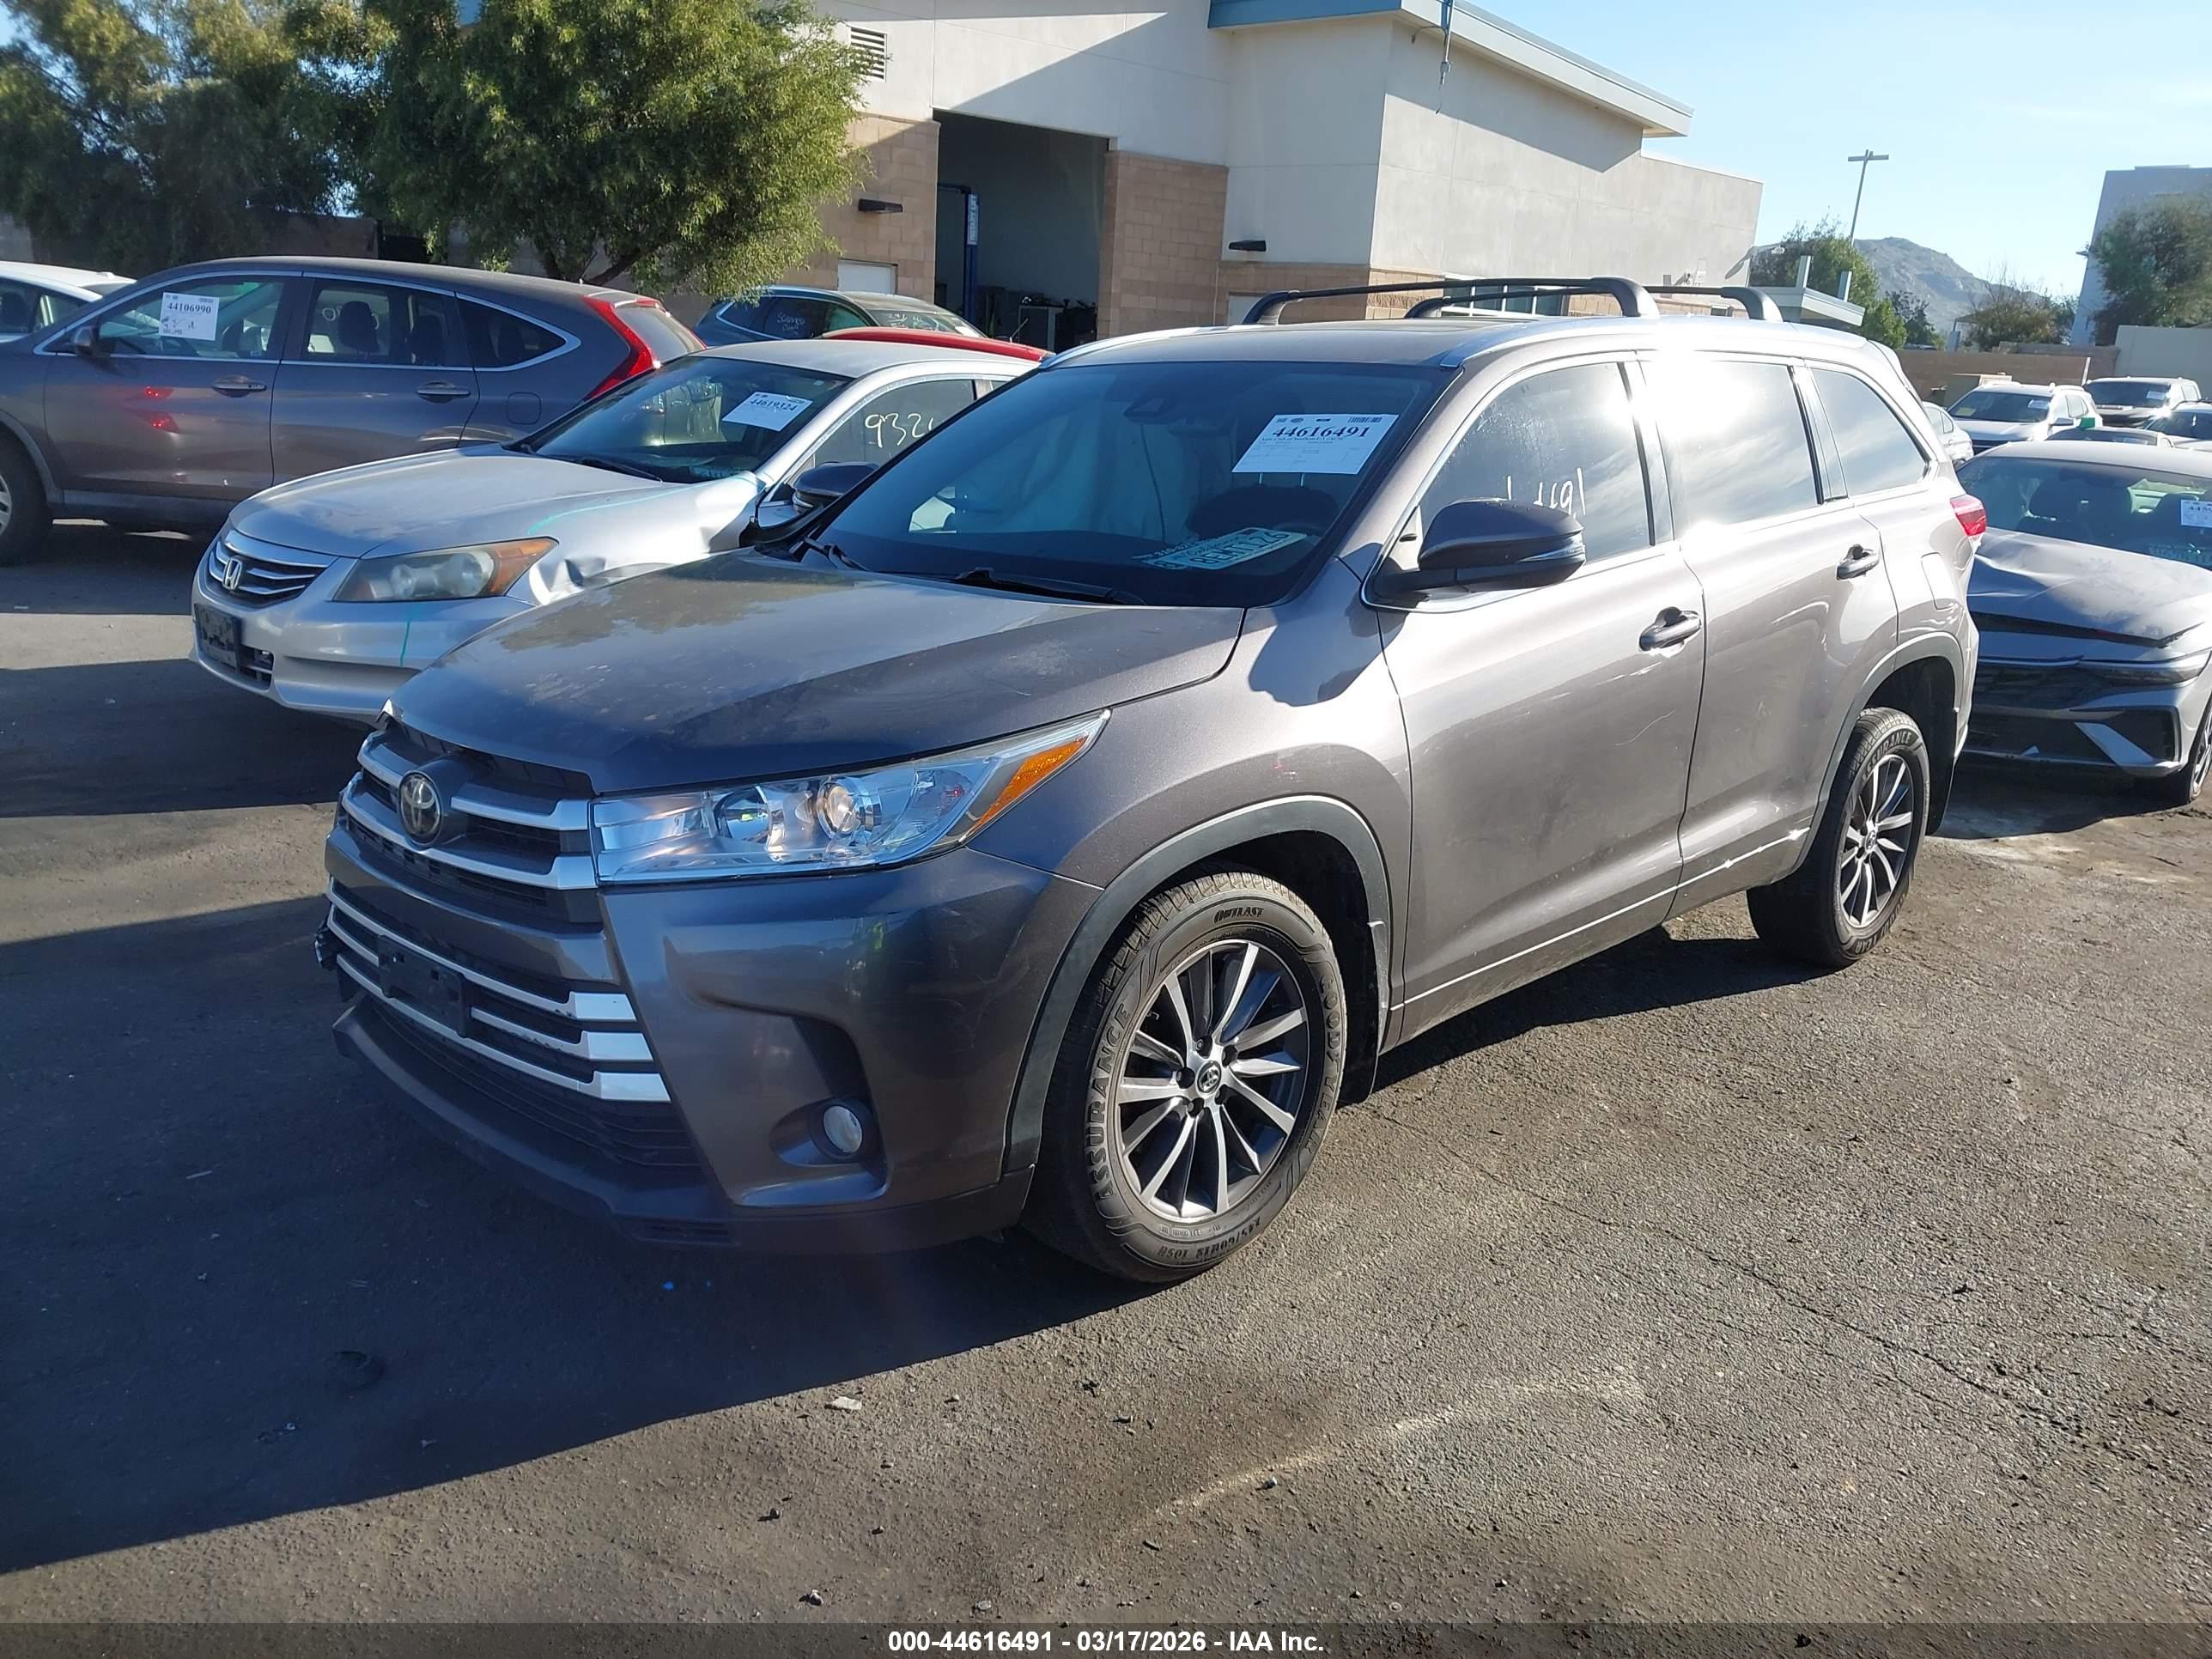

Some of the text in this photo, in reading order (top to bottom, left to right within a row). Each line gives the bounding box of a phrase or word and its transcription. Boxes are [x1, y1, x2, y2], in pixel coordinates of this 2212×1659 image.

[167, 301, 212, 314] 44106990
[750, 398, 798, 411] 44619324
[1272, 426, 1371, 438] 44616491
[1213, 906, 1265, 924] OUTLAST
[1085, 1002, 1132, 1200] ASSURANCE
